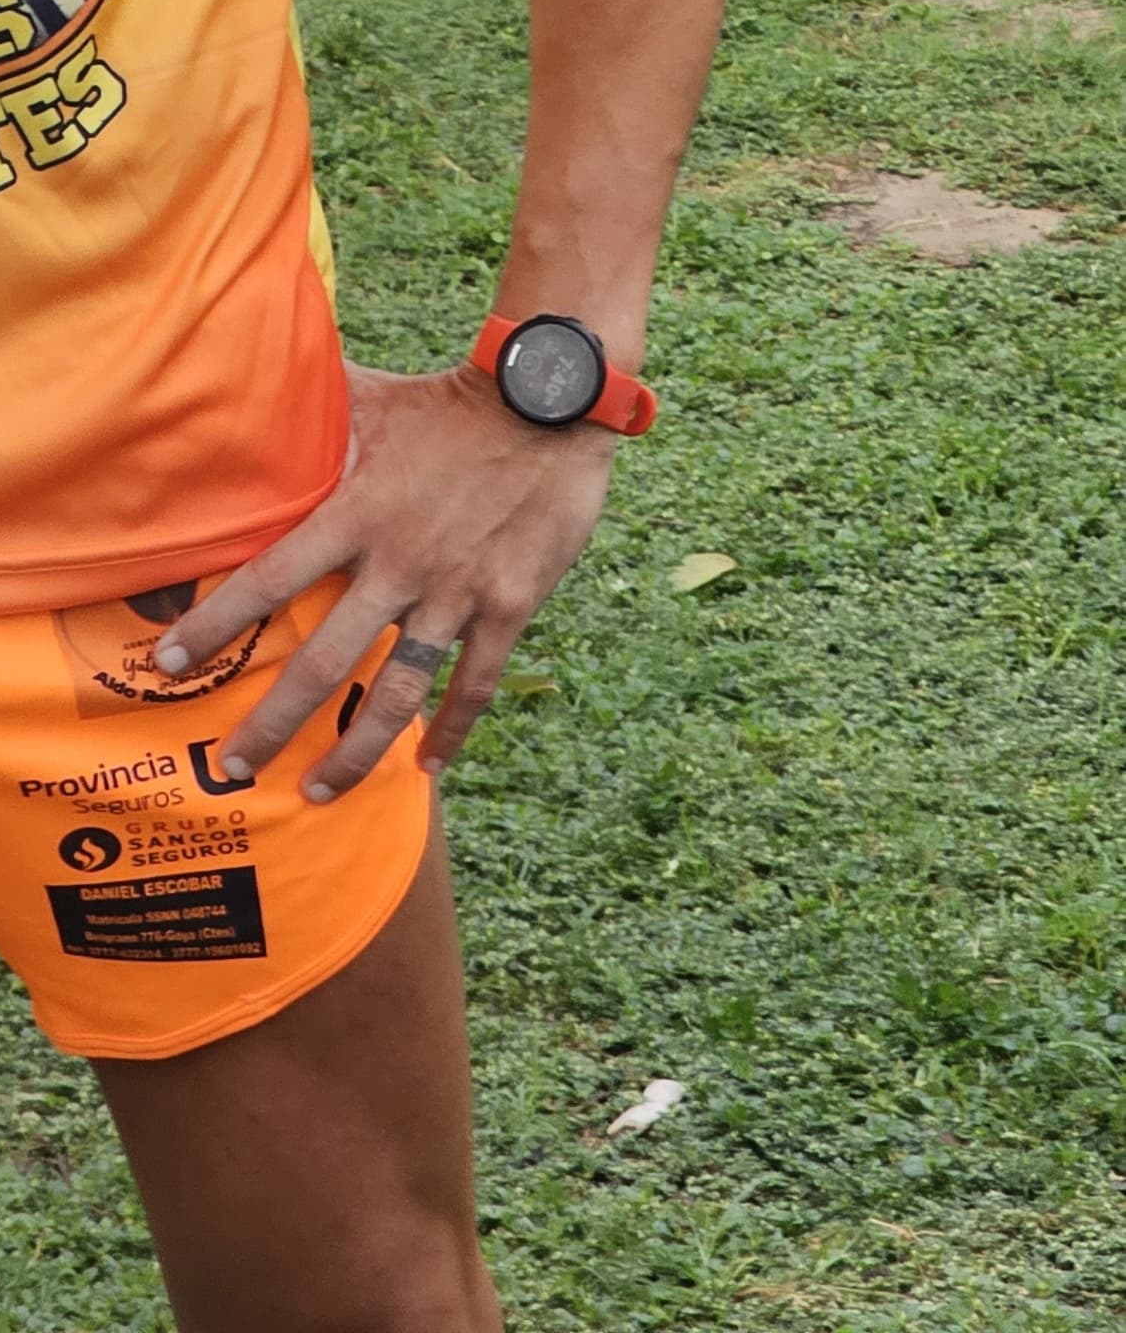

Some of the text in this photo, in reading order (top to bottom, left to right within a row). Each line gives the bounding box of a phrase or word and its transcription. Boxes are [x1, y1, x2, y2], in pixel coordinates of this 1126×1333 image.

[92, 671, 137, 699] Aldo
[18, 752, 178, 798] Provincia
[73, 787, 185, 815] Seguros
[125, 809, 246, 834] GRUPO
[128, 827, 249, 851] SANCOR
[131, 839, 250, 868] SEGUROS
[80, 875, 223, 901] DANIEL ESCOBAR
